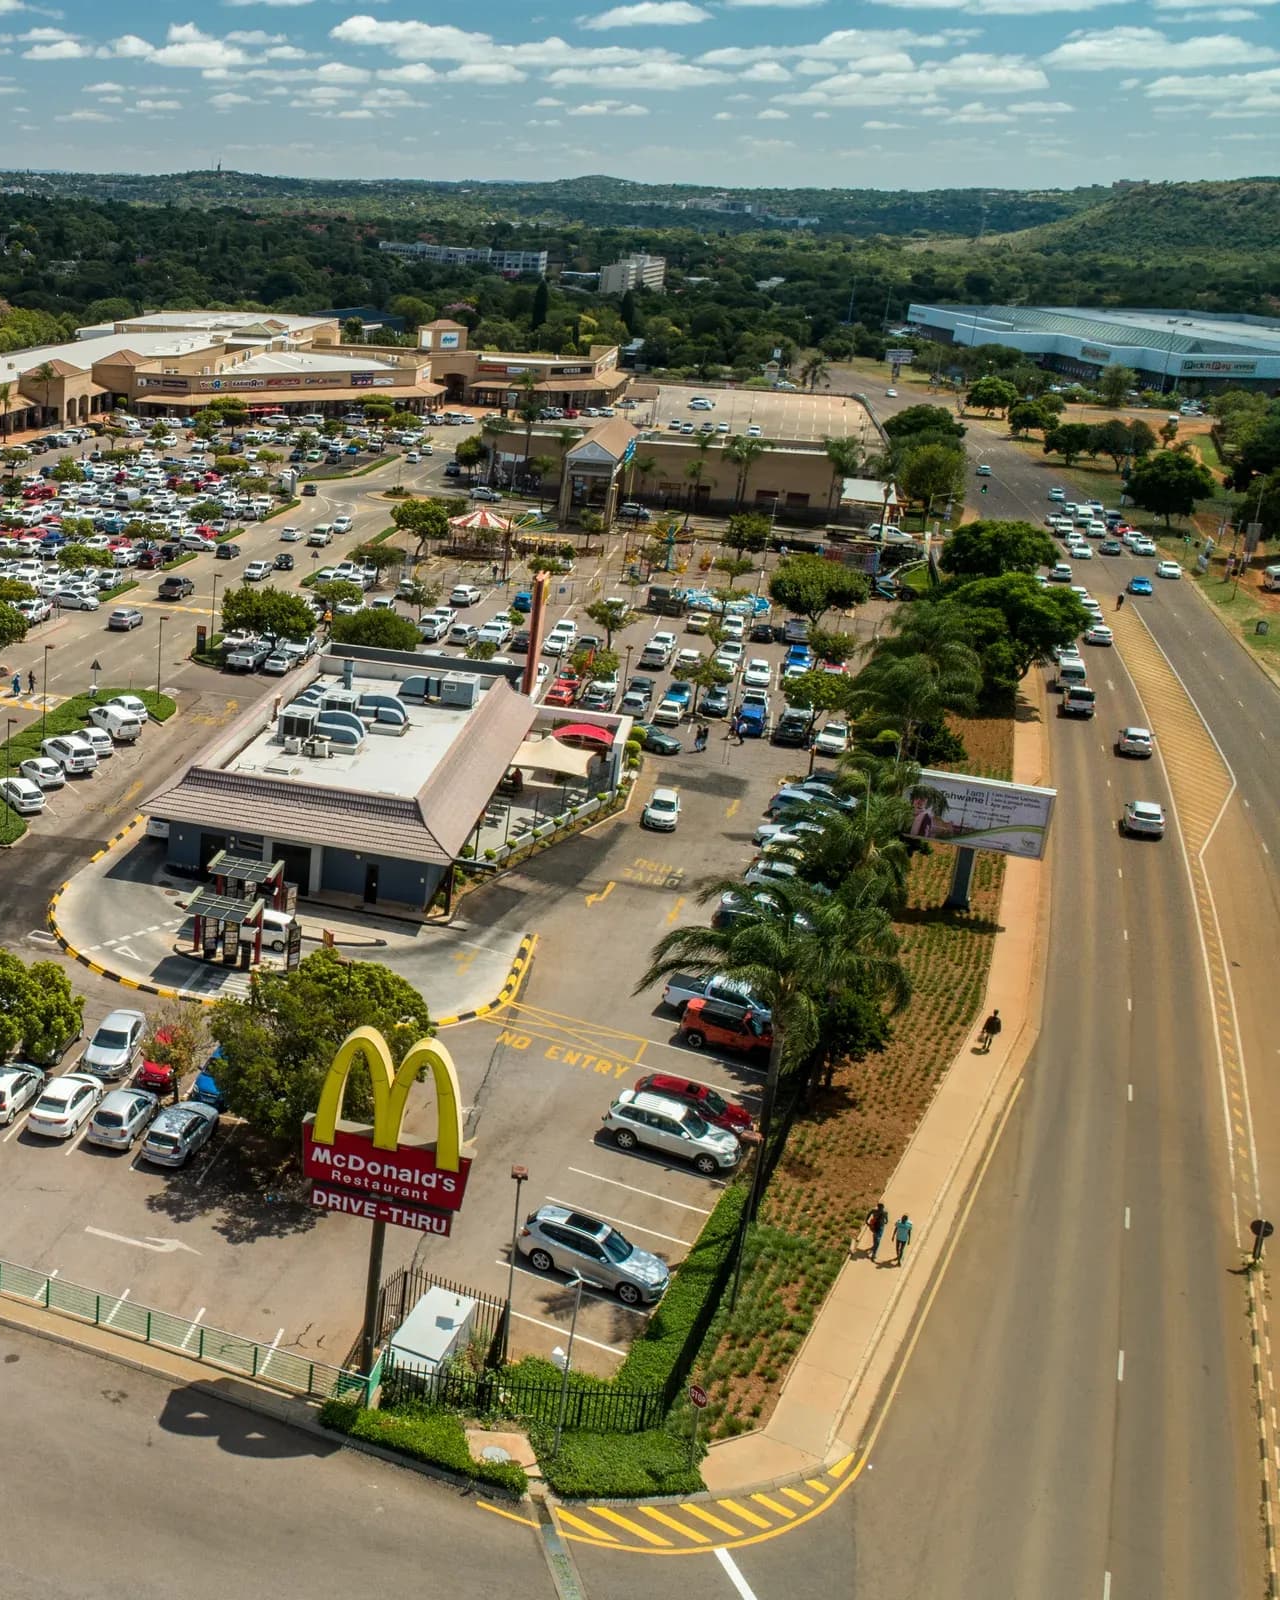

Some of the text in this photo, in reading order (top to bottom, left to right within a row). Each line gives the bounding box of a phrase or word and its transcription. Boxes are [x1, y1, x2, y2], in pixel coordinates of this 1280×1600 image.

[496, 1031, 630, 1079] NO ENTRY
[311, 1146, 456, 1193] McDonald's
[330, 1169, 429, 1201] Restaurant
[312, 1189, 447, 1234] DRIVE-THRU
[690, 1387, 706, 1405] STOP
